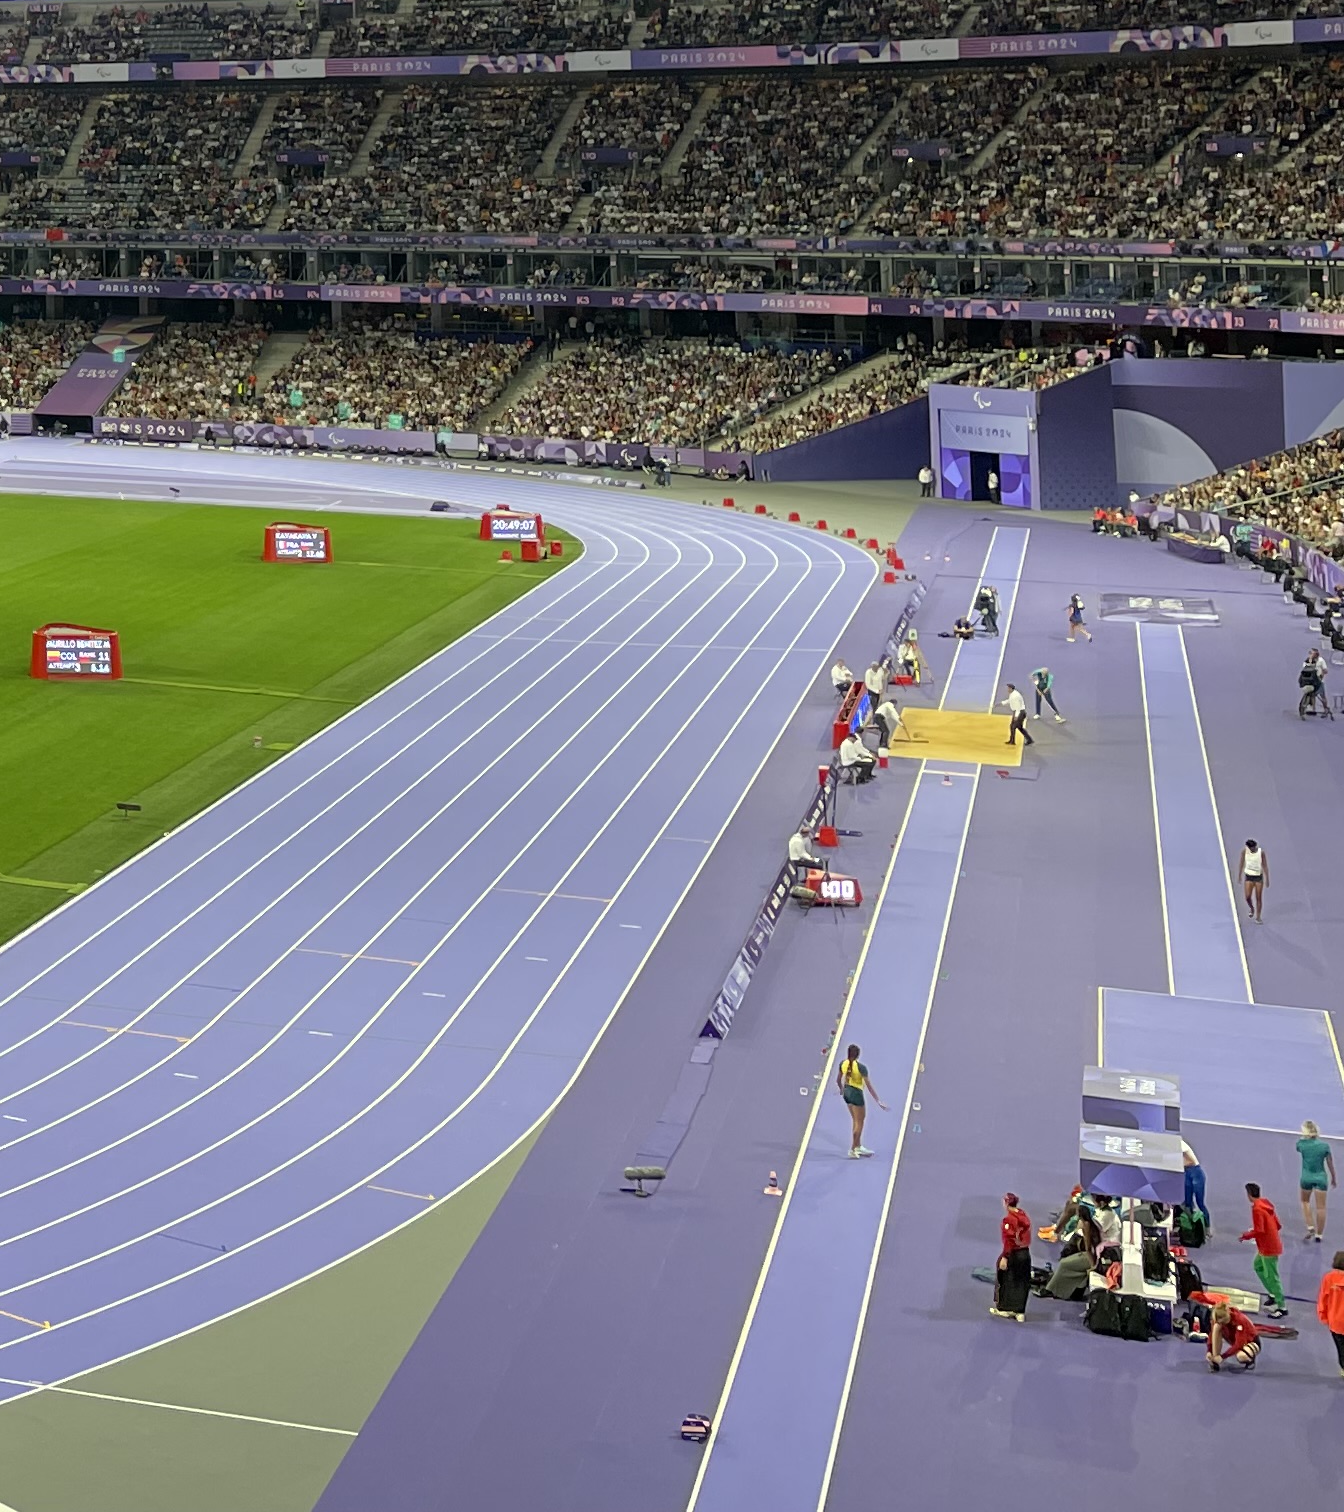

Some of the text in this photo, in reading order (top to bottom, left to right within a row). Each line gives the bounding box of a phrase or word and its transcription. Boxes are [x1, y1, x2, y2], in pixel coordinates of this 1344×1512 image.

[990, 38, 1077, 54] PARIS 2024
[661, 51, 746, 65] PARIS 2024
[352, 60, 431, 73] PARIS 2024
[99, 283, 160, 293] PARIS 2024
[328, 288, 393, 298] PARIS 2024
[500, 292, 567, 302] PARIS 2024
[576, 295, 590, 305] K3
[611, 296, 625, 306] K2
[761, 298, 830, 309] PARIS 2024
[871, 303, 882, 313] K1
[1048, 306, 1115, 319] PARIS 2024
[1300, 317, 1330, 328] PARIS
[147, 424, 185, 437] 2024
[955, 424, 1011, 438] PARIS 2024
[492, 519, 536, 531] 20:49:07
[60, 651, 78, 661] COL
[98, 651, 110, 662] 11
